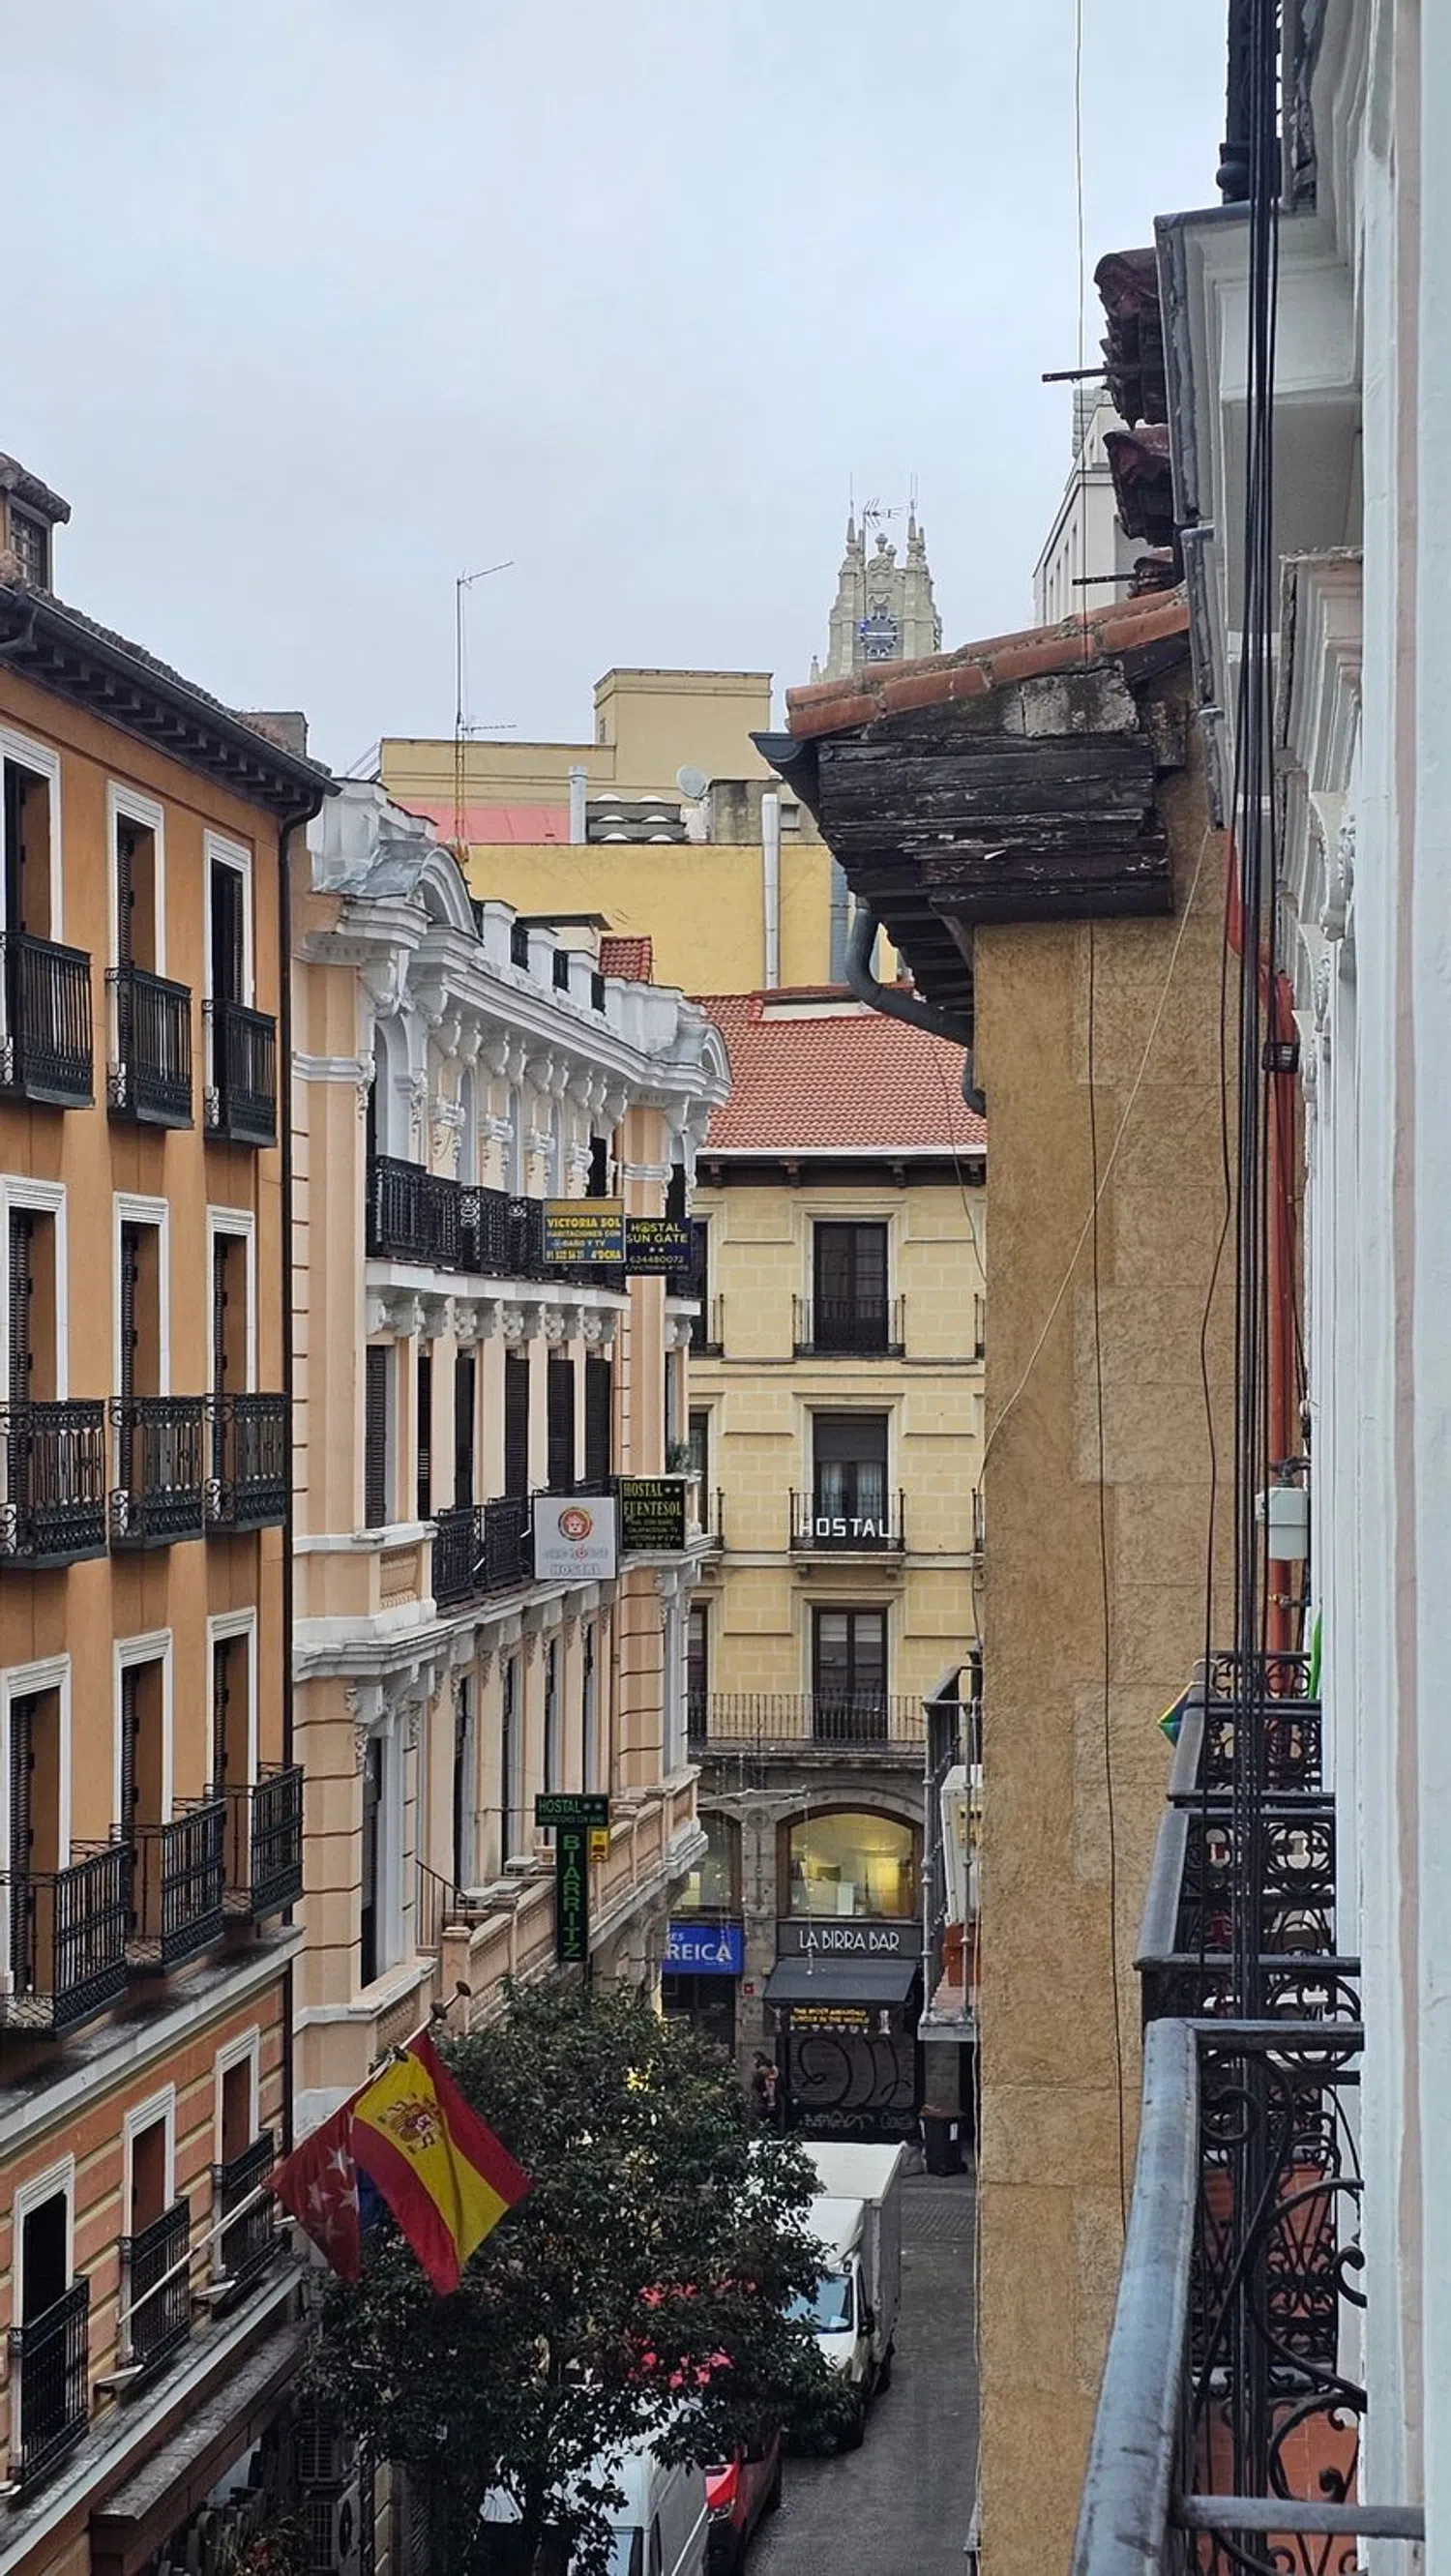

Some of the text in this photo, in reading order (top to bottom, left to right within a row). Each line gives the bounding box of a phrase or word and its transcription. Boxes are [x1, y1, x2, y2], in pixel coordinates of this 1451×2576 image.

[547, 1217, 622, 1229] VICTORIA SOL
[631, 1223, 682, 1233] HOSTAL
[627, 1233, 688, 1244] SUN GATE
[623, 1482, 664, 1498] HOSTAL
[623, 1500, 682, 1516] FUENTESOL
[799, 1518, 892, 1538] HOSTAL
[538, 1799, 581, 1814] HOSTAL
[562, 1834, 581, 1958] BIARRITZ
[799, 1930, 900, 1951] LA BIRRA BAR
